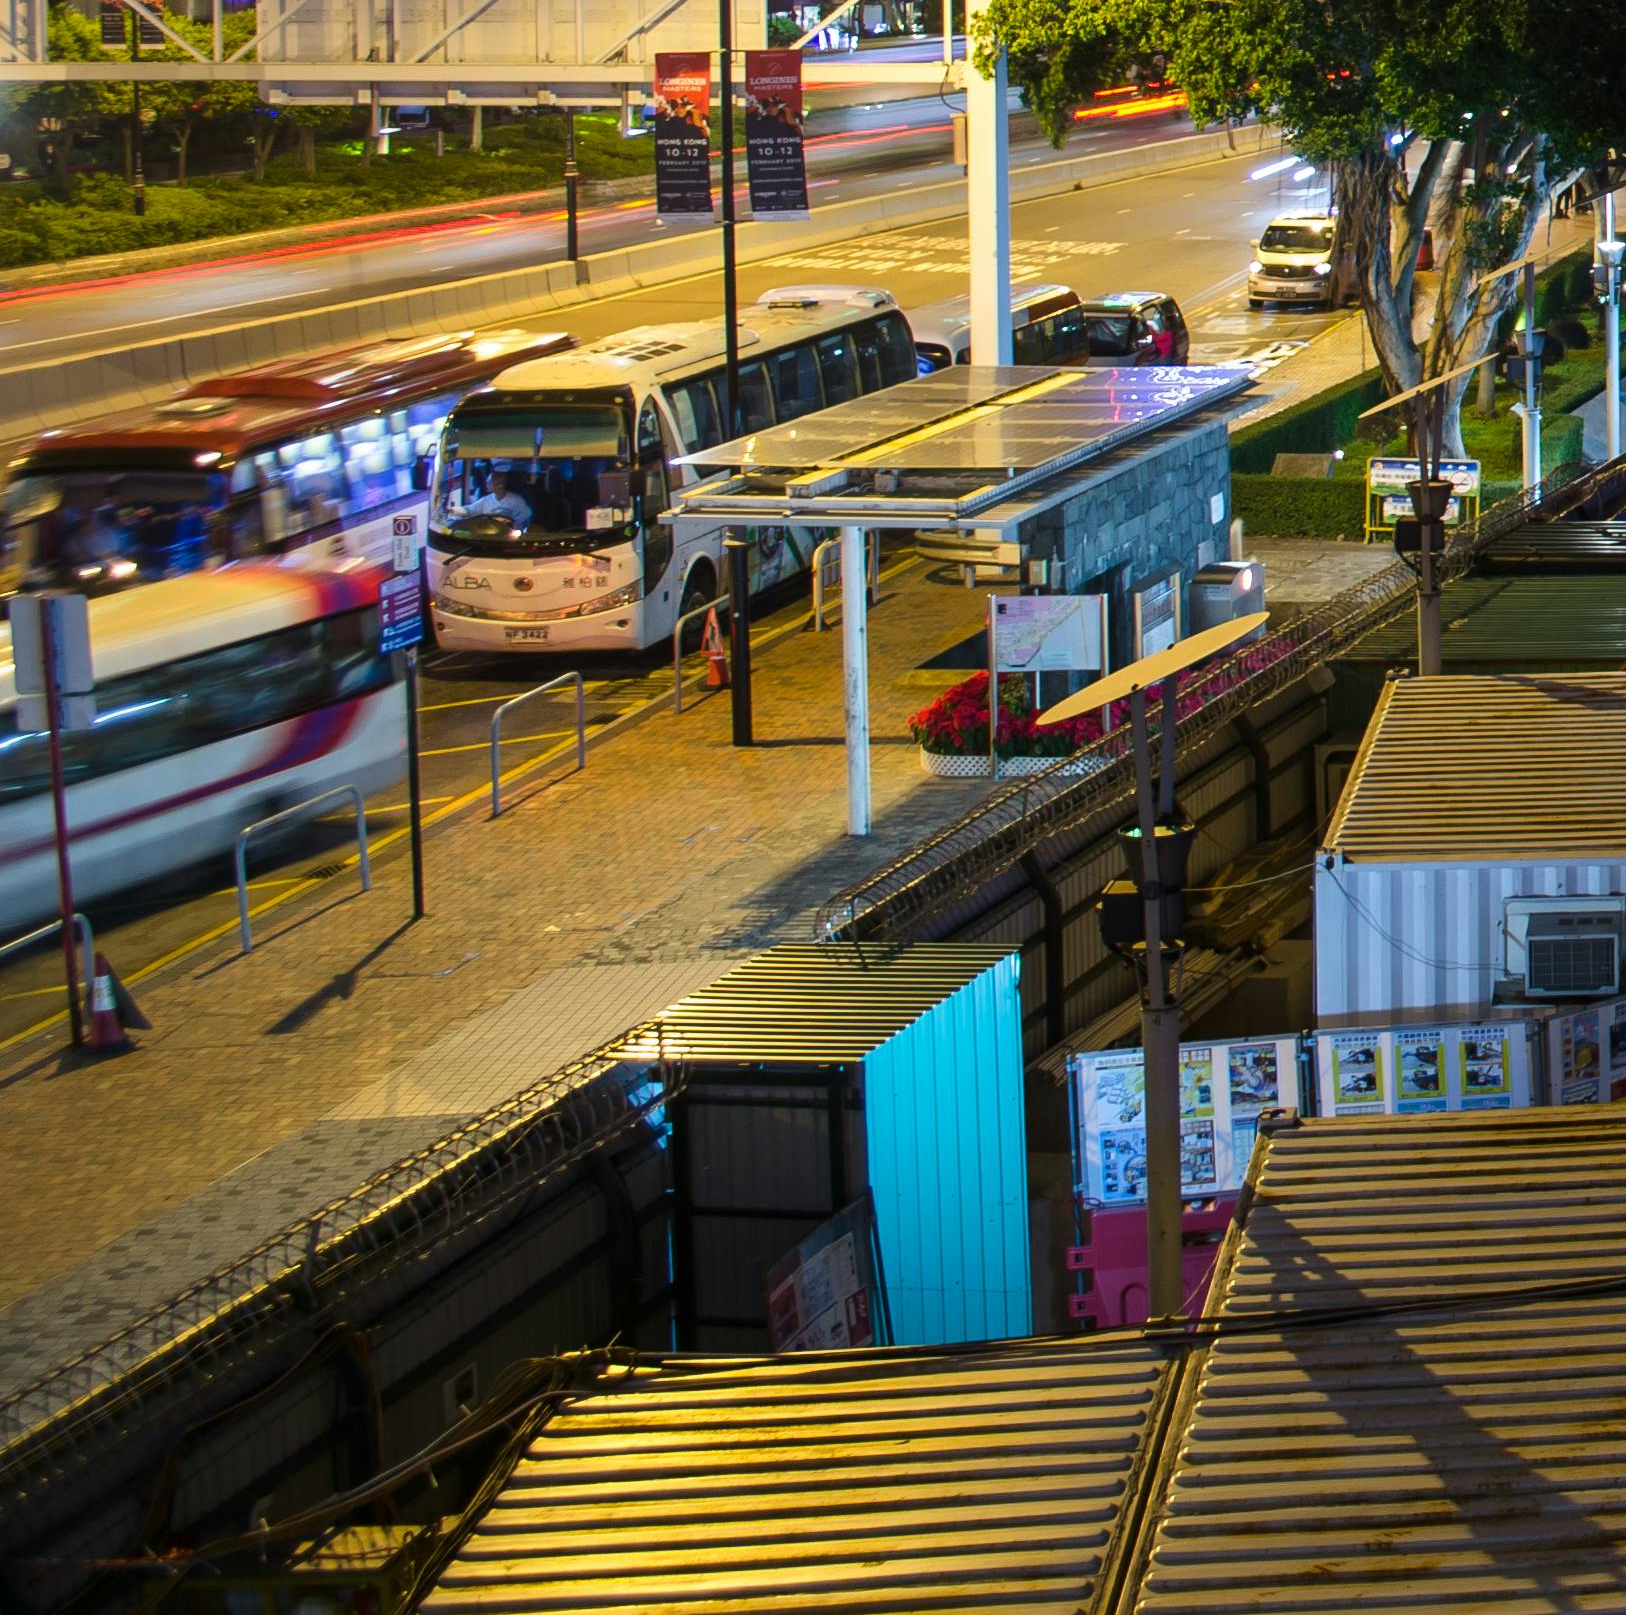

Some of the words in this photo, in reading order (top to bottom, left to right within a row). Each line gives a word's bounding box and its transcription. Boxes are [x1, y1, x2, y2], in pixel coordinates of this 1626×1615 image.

[659, 77, 707, 86] LONGINES
[750, 75, 798, 85] LONGINES
[657, 138, 682, 146] HONG
[684, 138, 708, 146] KONG
[749, 138, 775, 146] HONG
[777, 136, 802, 145] KONG
[441, 576, 493, 591] ALBA
[520, 629, 549, 640] 3422
